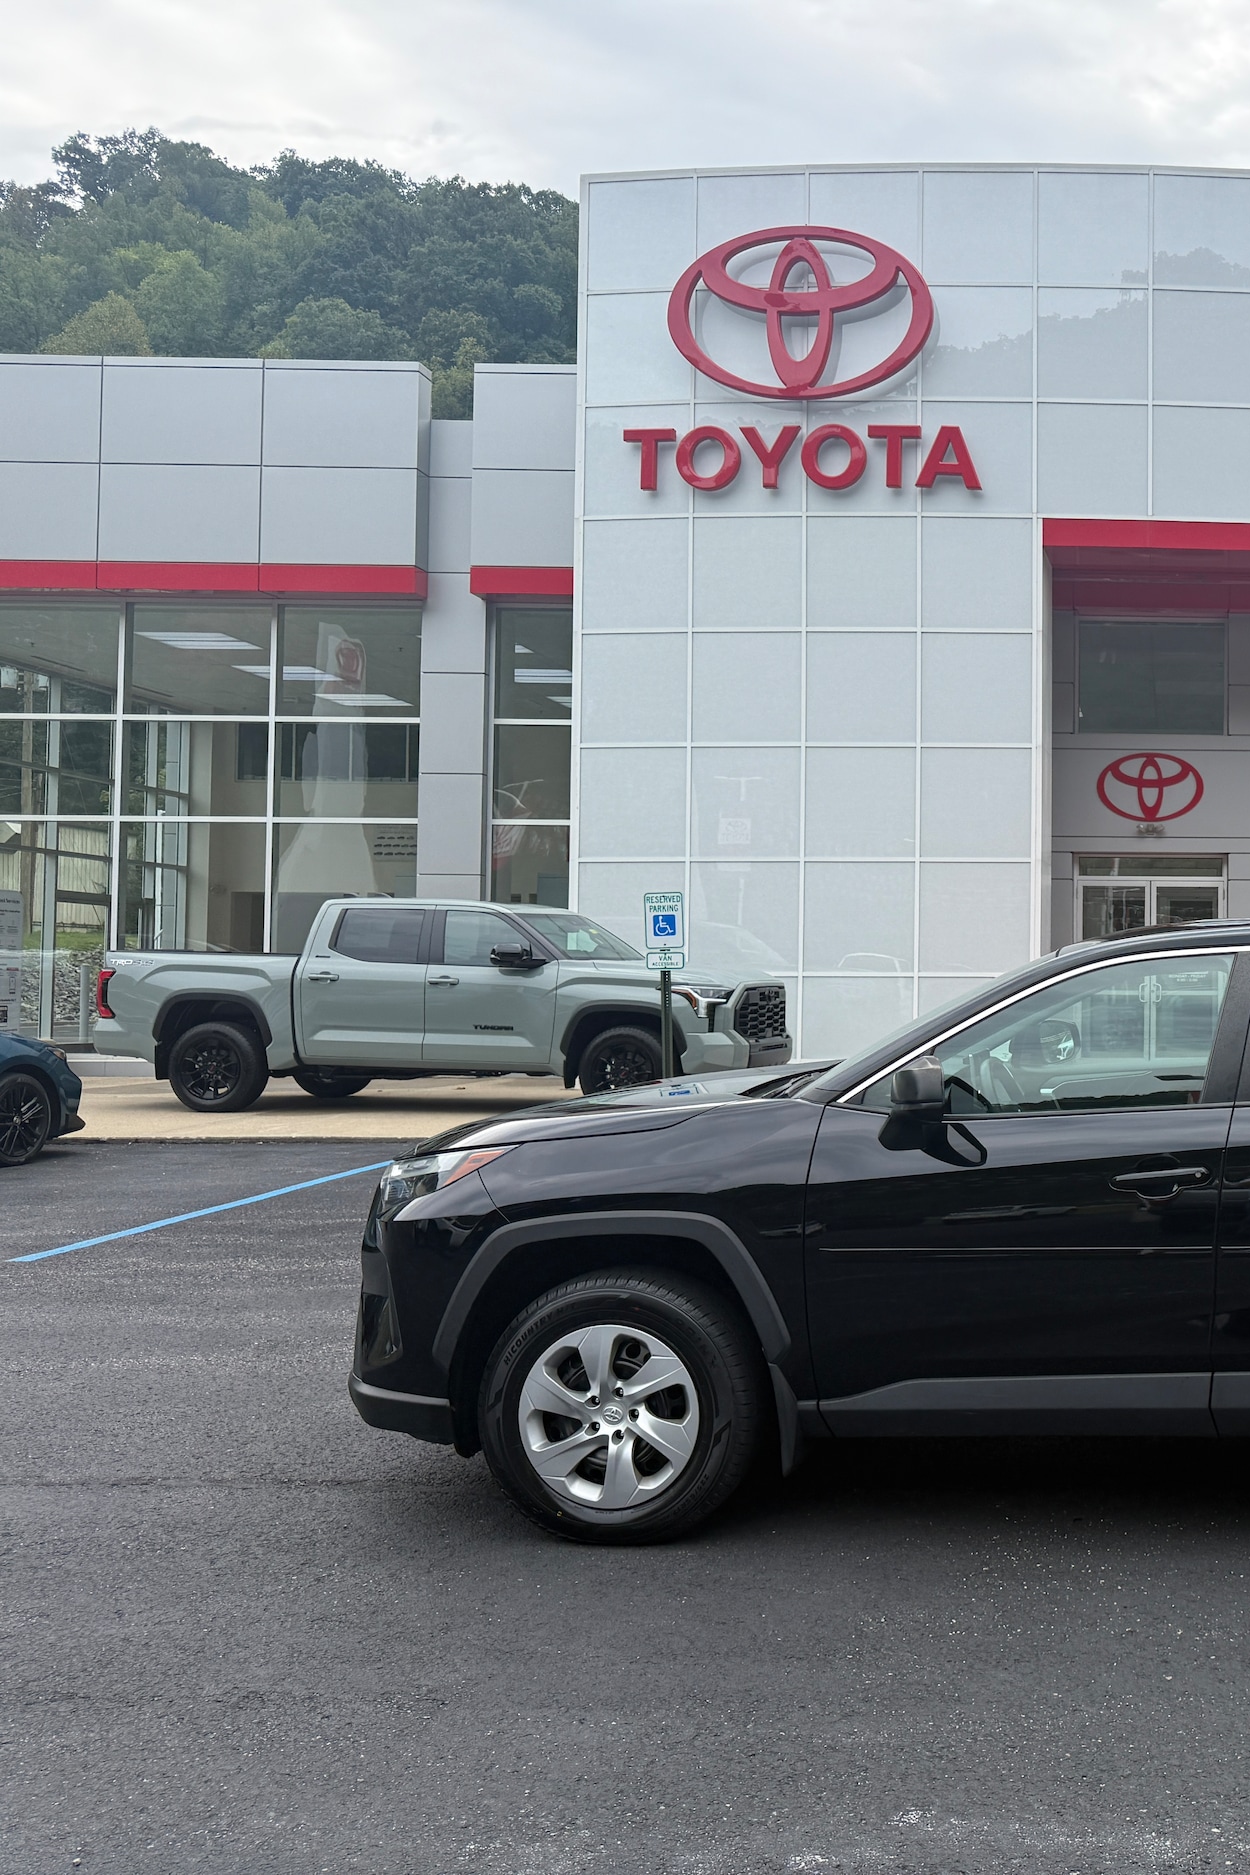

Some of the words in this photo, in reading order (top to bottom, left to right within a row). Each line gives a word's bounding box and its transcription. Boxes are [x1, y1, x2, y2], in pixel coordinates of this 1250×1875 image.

[623, 423, 983, 491] TOYOTA
[646, 895, 681, 904] RESERVED
[649, 904, 679, 913] PARKING
[503, 1311, 554, 1366] HICOUNTRY
